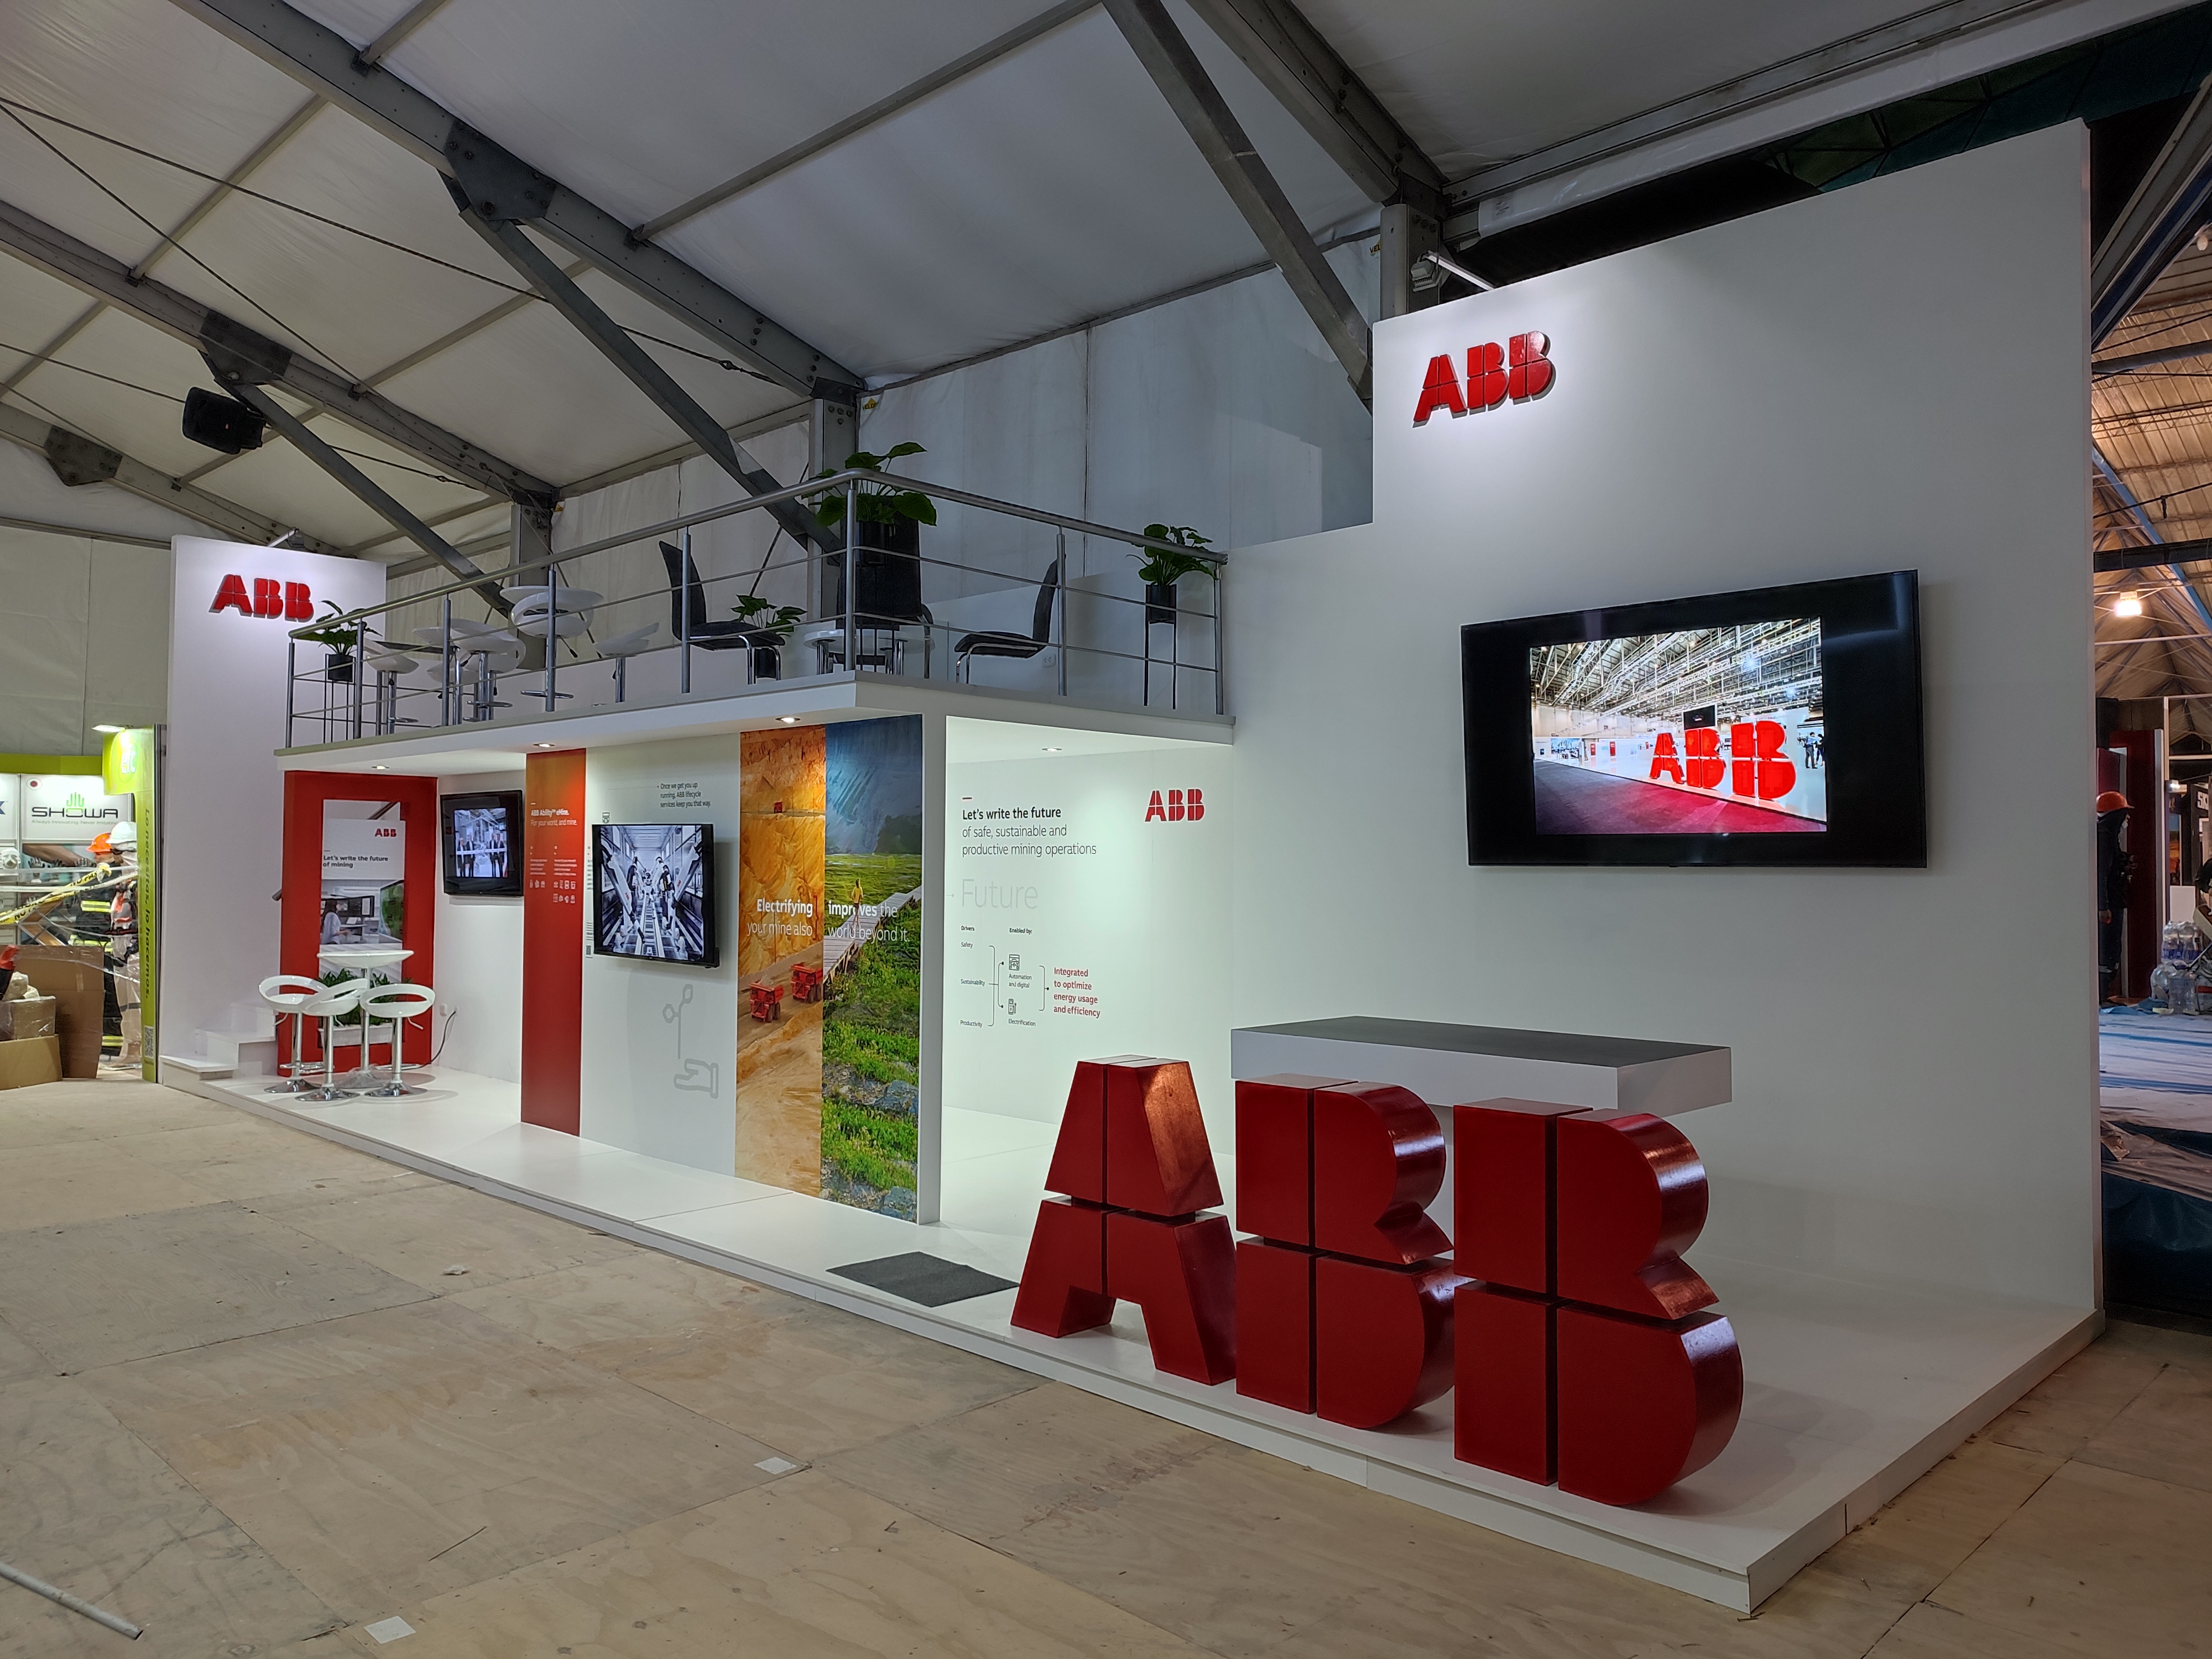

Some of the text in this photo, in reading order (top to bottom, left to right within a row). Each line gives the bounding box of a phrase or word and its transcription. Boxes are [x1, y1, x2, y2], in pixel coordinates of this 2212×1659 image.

[1413, 331, 1556, 427] ABB
[208, 574, 314, 623] ABB
[1649, 721, 1796, 800] ABB
[685, 790, 701, 799] lifecycle
[32, 807, 118, 818] SHOWA
[986, 807, 1010, 819] write
[1013, 807, 1029, 818] the
[1031, 806, 1061, 818] future
[1145, 789, 1204, 822] ABB
[374, 828, 397, 837] ABB
[962, 823, 1067, 839] of safe, sustainable and
[962, 843, 1097, 858] productive mining operations
[962, 878, 1038, 910] Future
[757, 898, 813, 918] Electrifying
[880, 904, 898, 918] the
[747, 921, 813, 936] your mine also
[828, 925, 911, 945] world beyond it.
[1054, 967, 1088, 977] Integrated
[961, 978, 985, 987] Sustainability
[1063, 982, 1092, 990] optimize
[1053, 993, 1098, 1004] energy usage
[1053, 1005, 1101, 1019] and efficiency
[960, 1020, 983, 1028] Productivity
[1008, 1019, 1036, 1027] Electrification
[1010, 1054, 1744, 1506] ABB
